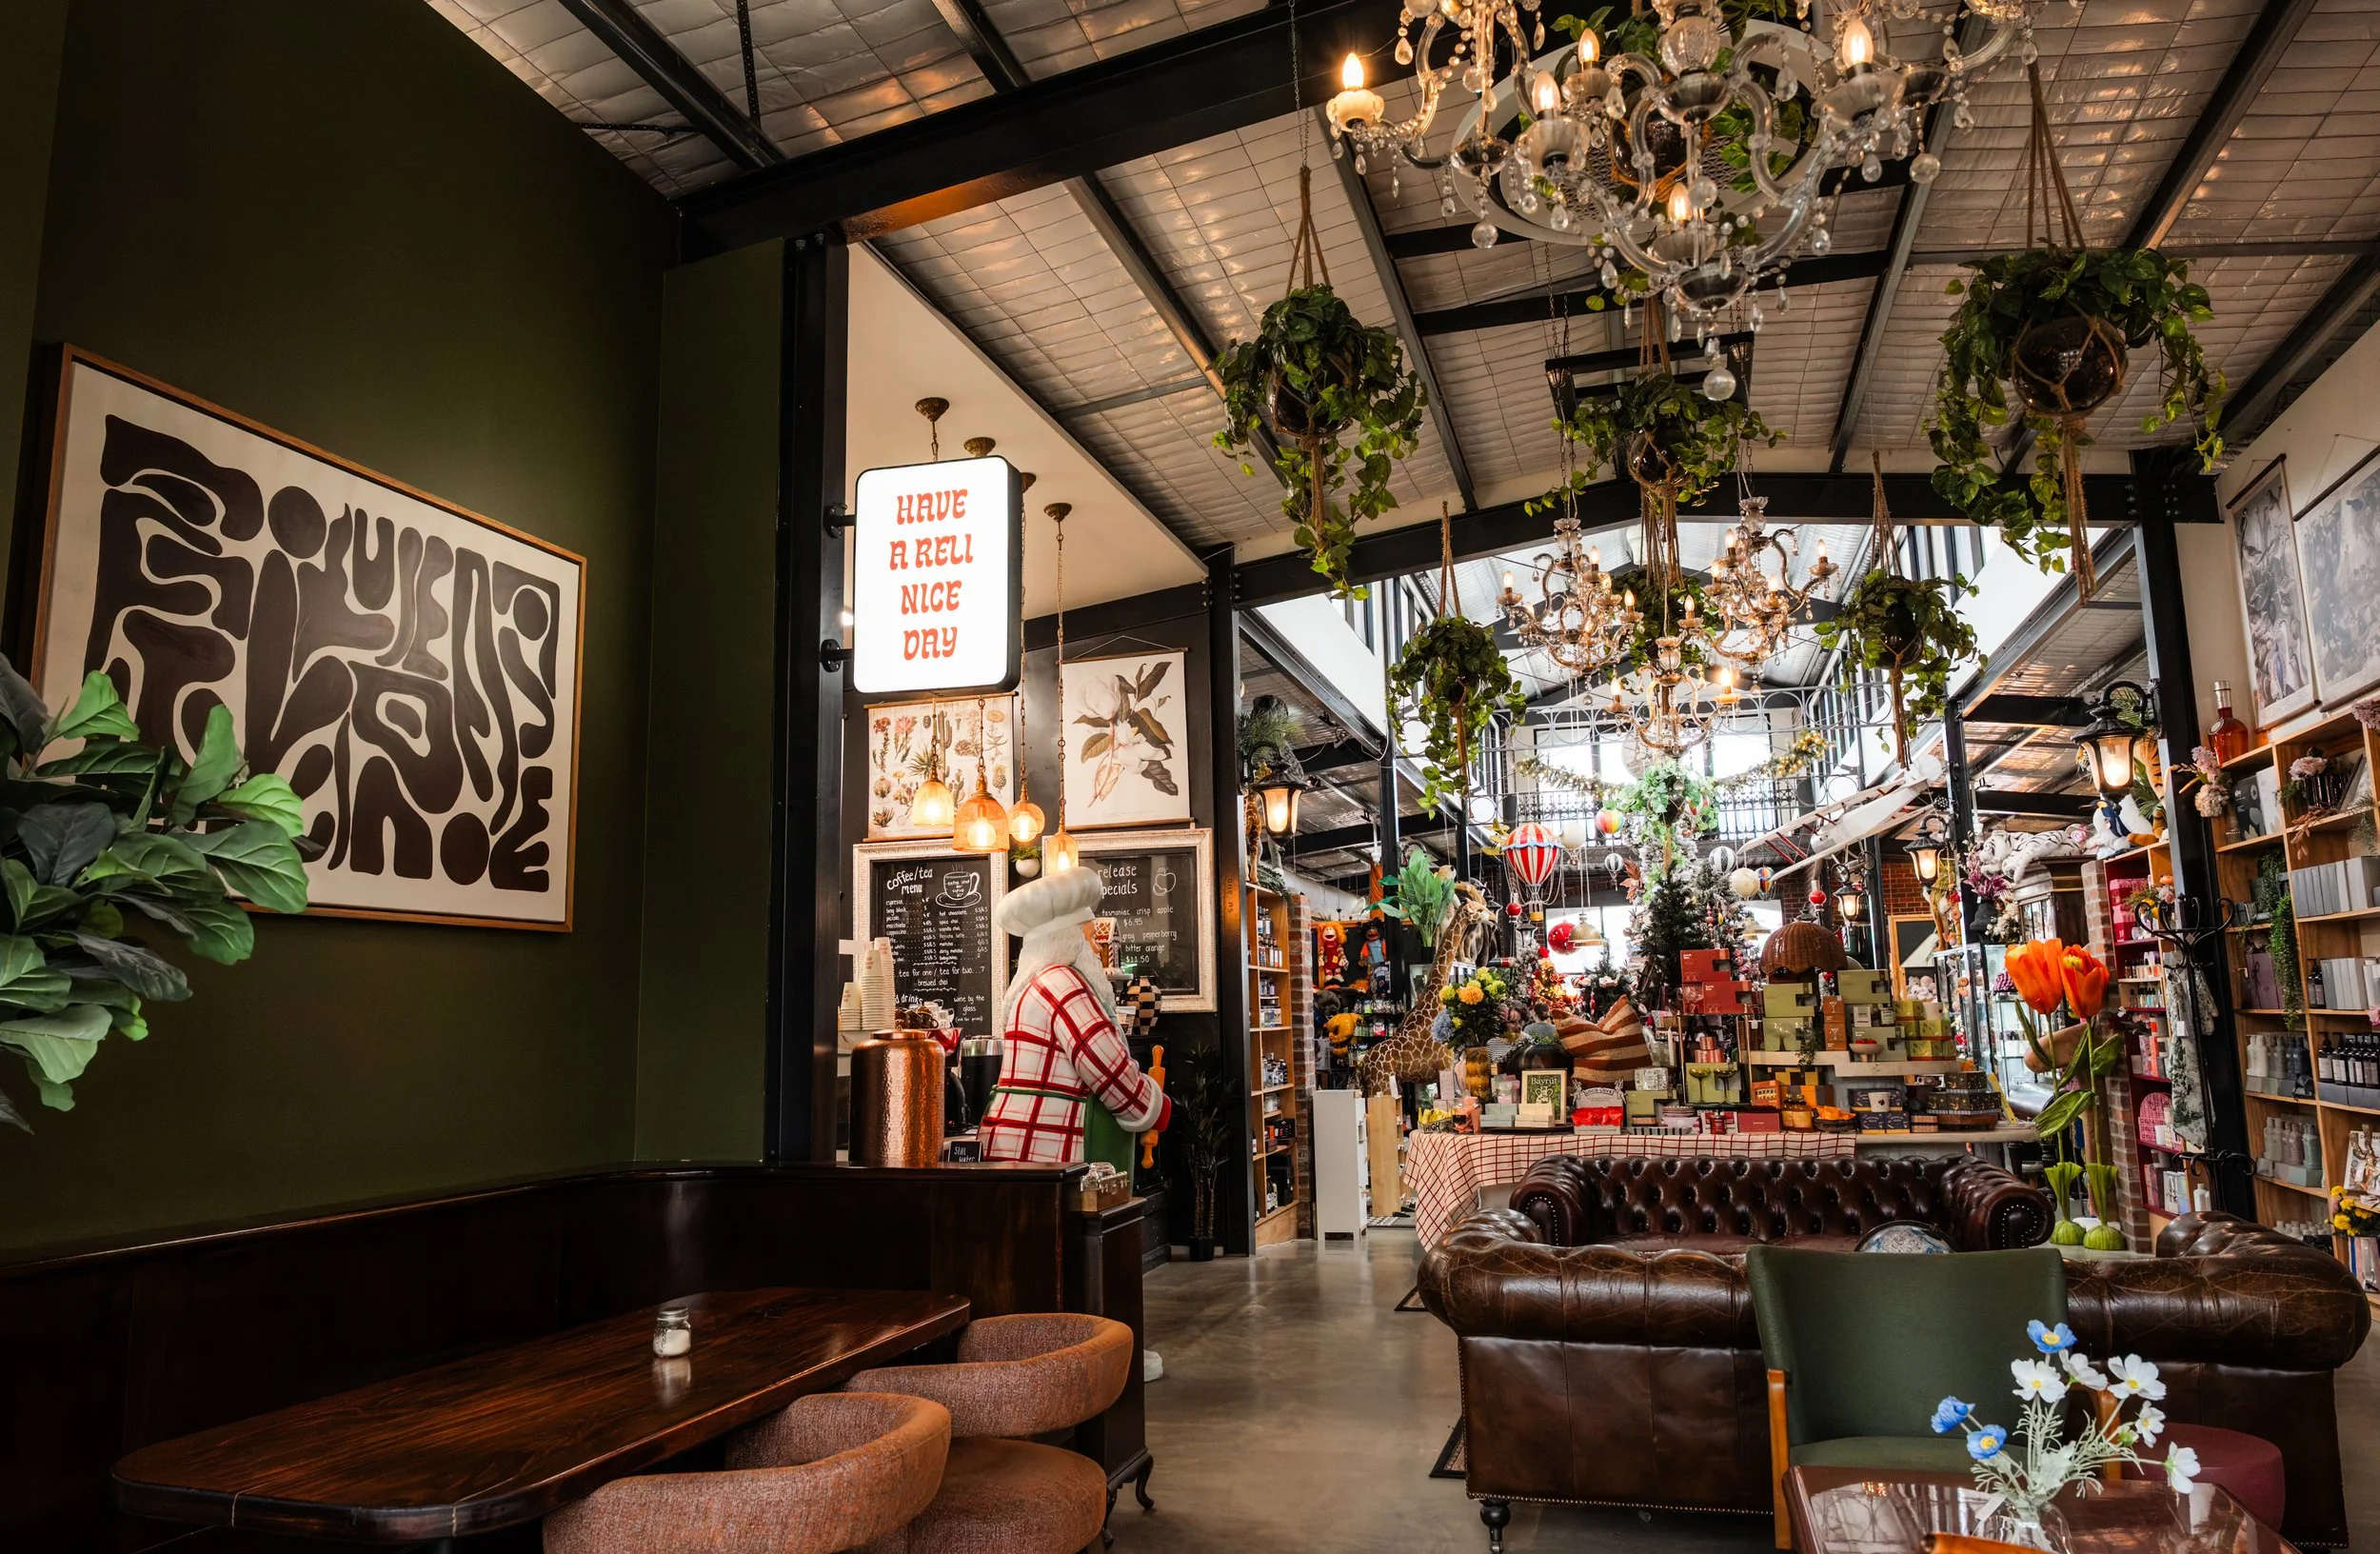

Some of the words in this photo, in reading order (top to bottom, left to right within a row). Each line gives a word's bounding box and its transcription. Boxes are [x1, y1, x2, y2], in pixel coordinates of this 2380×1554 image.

[896, 488, 969, 526] HAVE
[889, 539, 909, 571] A
[901, 579, 962, 615] NICE
[902, 626, 959, 661] DAY
[1098, 864, 1136, 877] release
[887, 866, 932, 890] coffee/tea
[901, 884, 923, 894] menu
[1102, 879, 1137, 898] pecials
[1136, 908, 1150, 917] crisp
[1156, 904, 1173, 915] apple
[1124, 917, 1143, 927] $6.95
[1143, 931, 1177, 941] pepperberry
[1145, 945, 1165, 954] orange
[898, 969, 910, 977] tea
[939, 966, 950, 975] tea
[952, 966, 960, 975] for
[901, 994, 923, 1005] drinks
[968, 996, 974, 1005] by
[962, 1005, 976, 1016] glass
